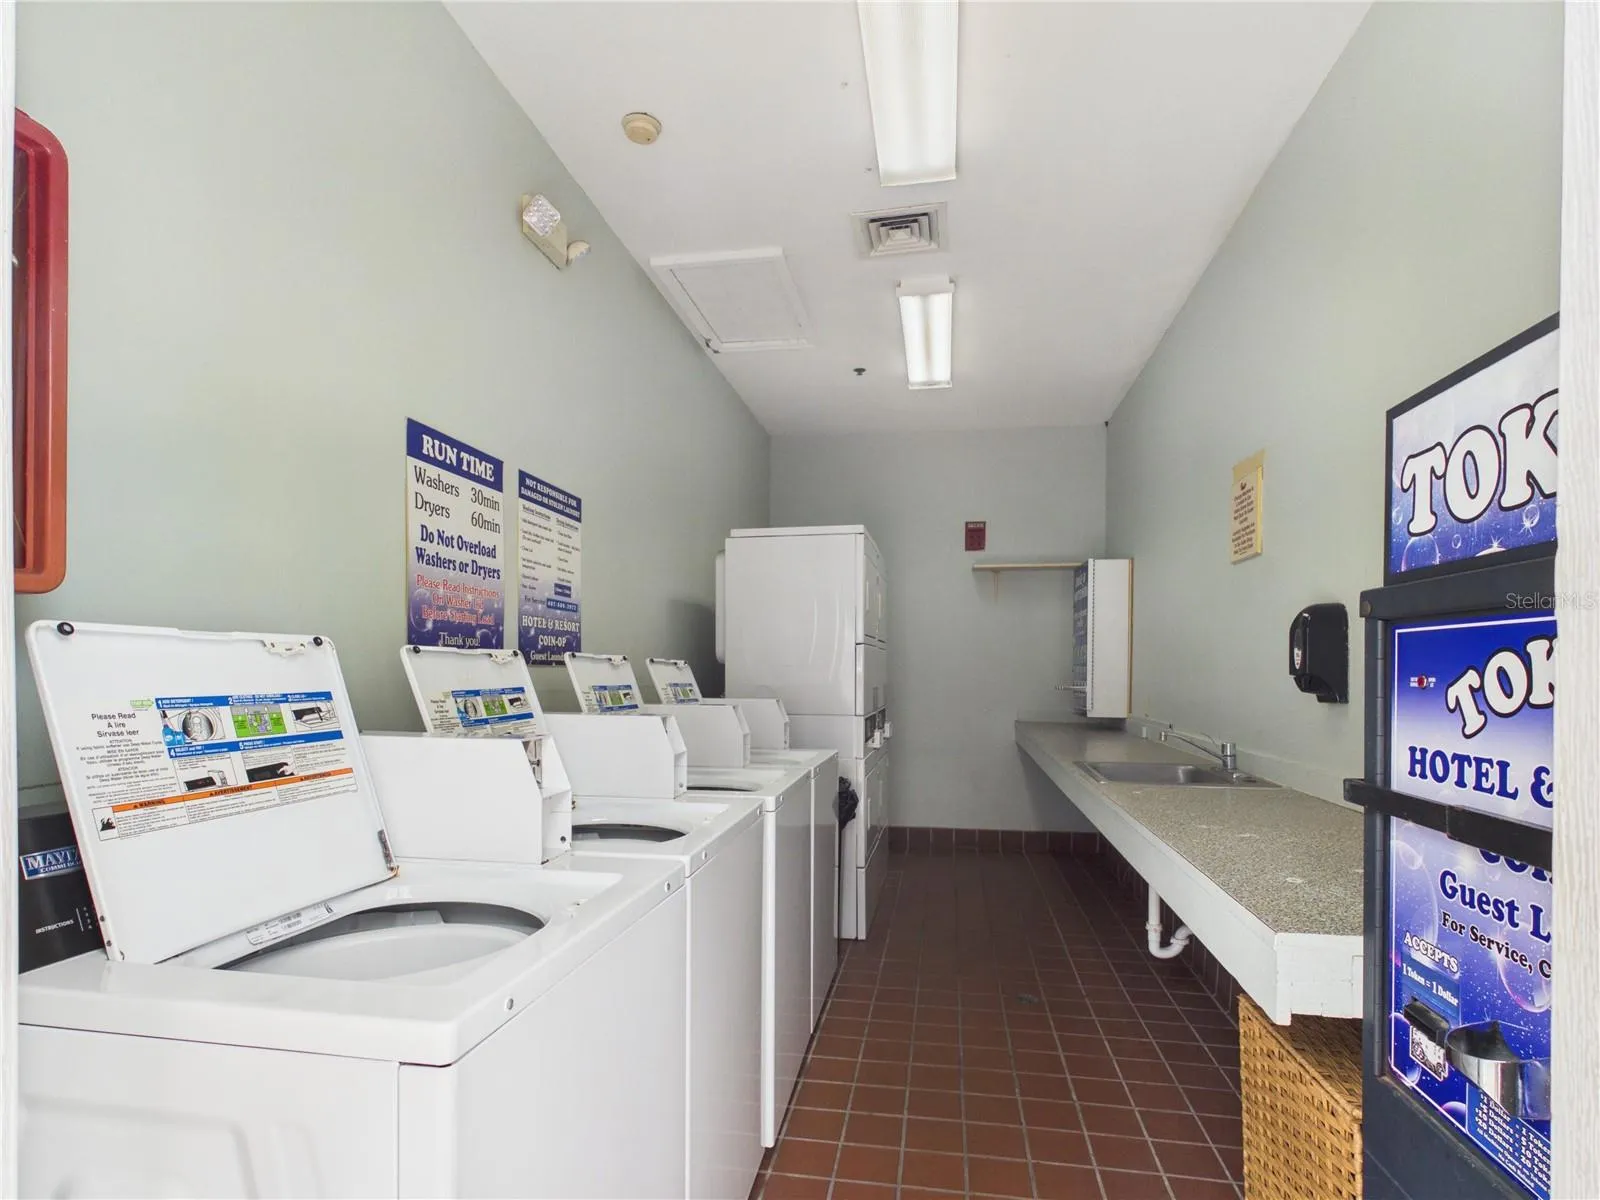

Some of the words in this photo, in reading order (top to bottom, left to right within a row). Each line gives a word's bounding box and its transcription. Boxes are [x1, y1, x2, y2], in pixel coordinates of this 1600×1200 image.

[422, 434, 457, 467] RUN
[460, 451, 495, 482] TIME
[1400, 388, 1558, 538] TOK
[414, 465, 460, 498] Washers
[470, 487, 500, 512] 30min
[521, 486, 542, 502] DAMAGED
[525, 478, 537, 489] NOT
[537, 482, 568, 504] RESPONSIBLE
[568, 496, 577, 508] FOR
[415, 491, 450, 519] Dryers
[471, 511, 501, 534] 60min
[421, 524, 435, 543] Do
[437, 529, 455, 549] Not
[457, 535, 497, 559] Overload
[415, 546, 457, 571] Washers
[459, 560, 469, 574] or
[471, 560, 501, 580] Dryers
[416, 574, 440, 590] Please
[442, 579, 461, 593] Read
[462, 583, 499, 599] Instructions
[432, 592, 443, 604] On
[446, 595, 471, 608] Washer
[422, 605, 448, 620] Before
[522, 615, 546, 629] HOTEL
[548, 619, 554, 630] &
[555, 620, 580, 632] RESORT
[439, 631, 463, 647] Thank
[465, 637, 481, 649] you!
[538, 635, 567, 647] COIN-OP
[530, 651, 547, 661] Guest
[157, 699, 162, 708] 1
[228, 697, 233, 705] 2
[170, 749, 175, 757] 4
[1408, 745, 1519, 801] HOTEL
[1439, 870, 1520, 929] Guest
[35, 919, 75, 934] INSTRUCTIONS
[1404, 931, 1460, 974] ACCEPTS
[1442, 911, 1466, 936] For
[1469, 925, 1534, 974] Service,
[1402, 963, 1408, 976] 1
[1408, 966, 1425, 987] Token
[1431, 981, 1437, 994] 1
[1437, 985, 1459, 1007] Dollar
[1520, 1155, 1532, 1168] 20
[1521, 1145, 1532, 1159] 10
